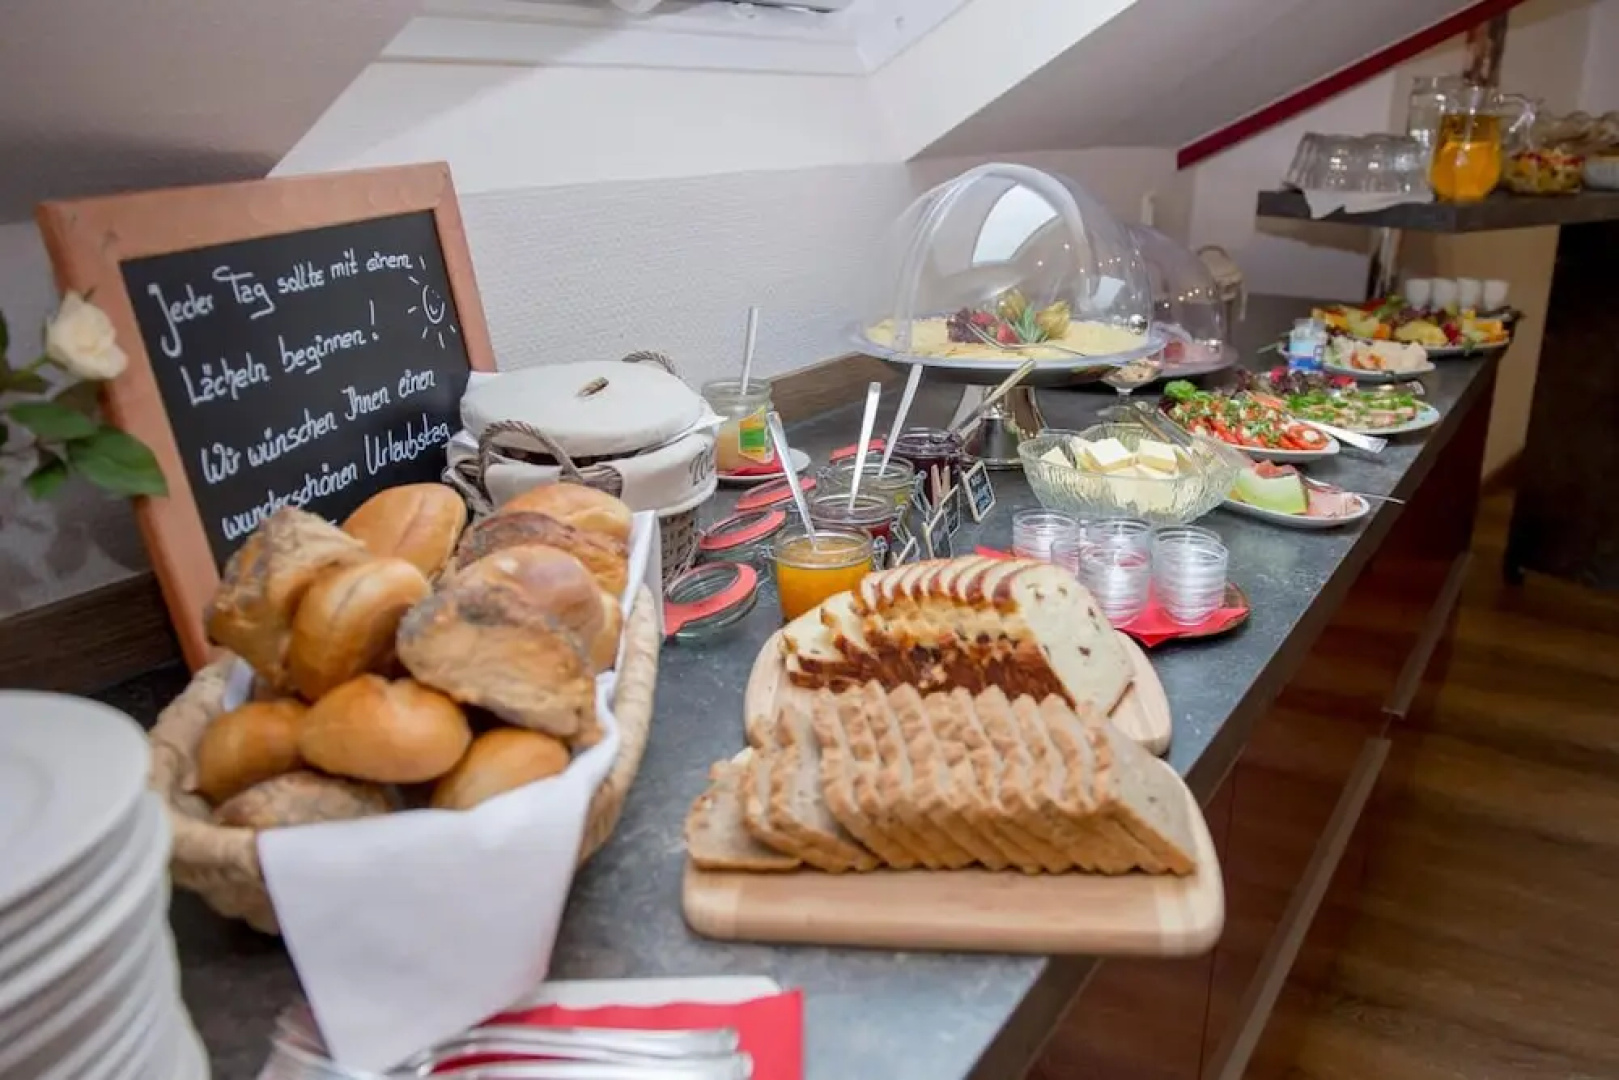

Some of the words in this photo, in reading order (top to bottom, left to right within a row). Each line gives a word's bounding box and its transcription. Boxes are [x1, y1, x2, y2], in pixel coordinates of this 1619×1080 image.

[147, 283, 213, 358] Jeder
[212, 265, 276, 320] Tag
[277, 261, 325, 293] sollte
[330, 247, 358, 278] mit
[366, 251, 413, 271] einem
[179, 352, 272, 407] Lächeln
[200, 442, 241, 485] Wir
[247, 408, 338, 467] wünschen
[340, 385, 390, 421] Ihnen
[398, 369, 436, 398] einen
[221, 462, 358, 540] wunderschönen
[364, 413, 450, 475] Urlaubstag
